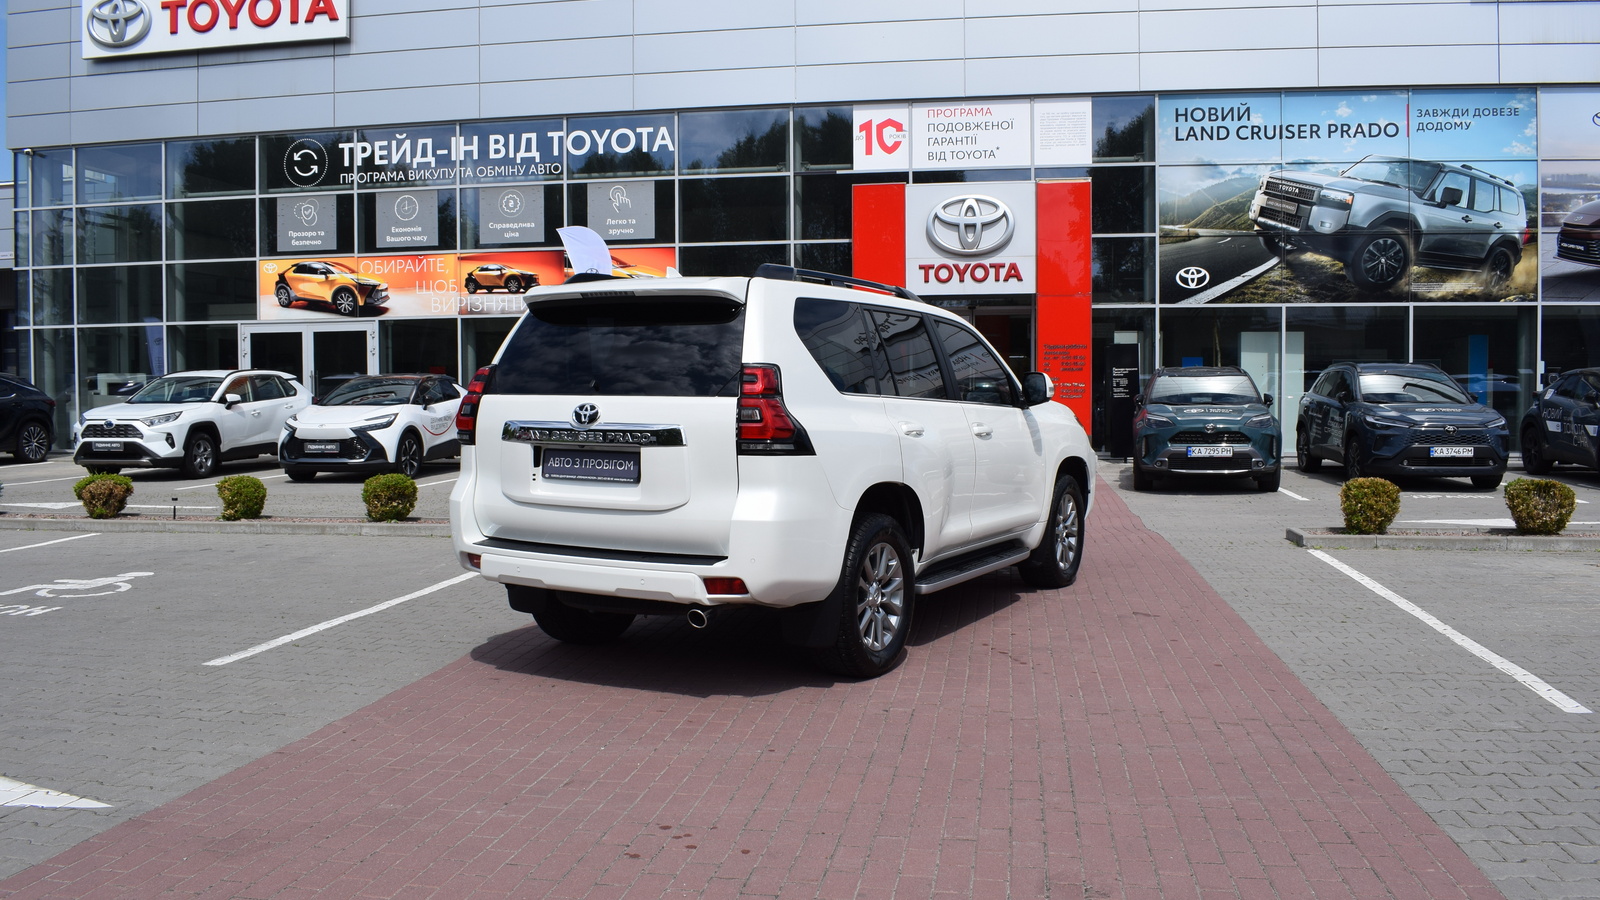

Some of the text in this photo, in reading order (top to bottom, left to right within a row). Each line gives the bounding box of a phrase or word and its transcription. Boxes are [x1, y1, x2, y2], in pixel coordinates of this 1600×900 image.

[161, 0, 339, 34] TOYOTA
[927, 107, 992, 118] ПРОГРАМА
[1174, 103, 1251, 123] НОВИЙ
[1416, 107, 1520, 120] ЗАВЖДИ ДОВЕЗЕ
[927, 119, 1015, 133] ПОДОВЖЕНОЇ
[1174, 121, 1400, 141] LAND CRUISER PRADO
[1416, 121, 1472, 133] ДОДОМУ
[927, 134, 978, 146] ГАРАНТІЇ
[338, 126, 675, 168] ТРЕЙД-ІН ВІД TOYOTA
[927, 151, 946, 162] ВІД
[340, 163, 562, 184] ПРОГРАМА ВИКУПУ ТА ОБМІНУ АВТО
[1279, 185, 1299, 194] TOYOTA
[488, 222, 535, 230] Справедлива
[606, 218, 626, 226] Легко
[288, 231, 315, 239] Прозоро
[391, 226, 422, 234] Економія
[608, 227, 634, 235] зручно
[360, 255, 449, 275] ОБИРАЙТЕ,
[918, 262, 1023, 284] TOYOTA
[416, 279, 458, 297] ЩОБ
[1542, 407, 1563, 419] НОВИЙ
[606, 432, 651, 443] PRADO
[1191, 447, 1231, 455] KA 7295 PH
[548, 458, 634, 471] АВТО З ПРОБІГОМ
